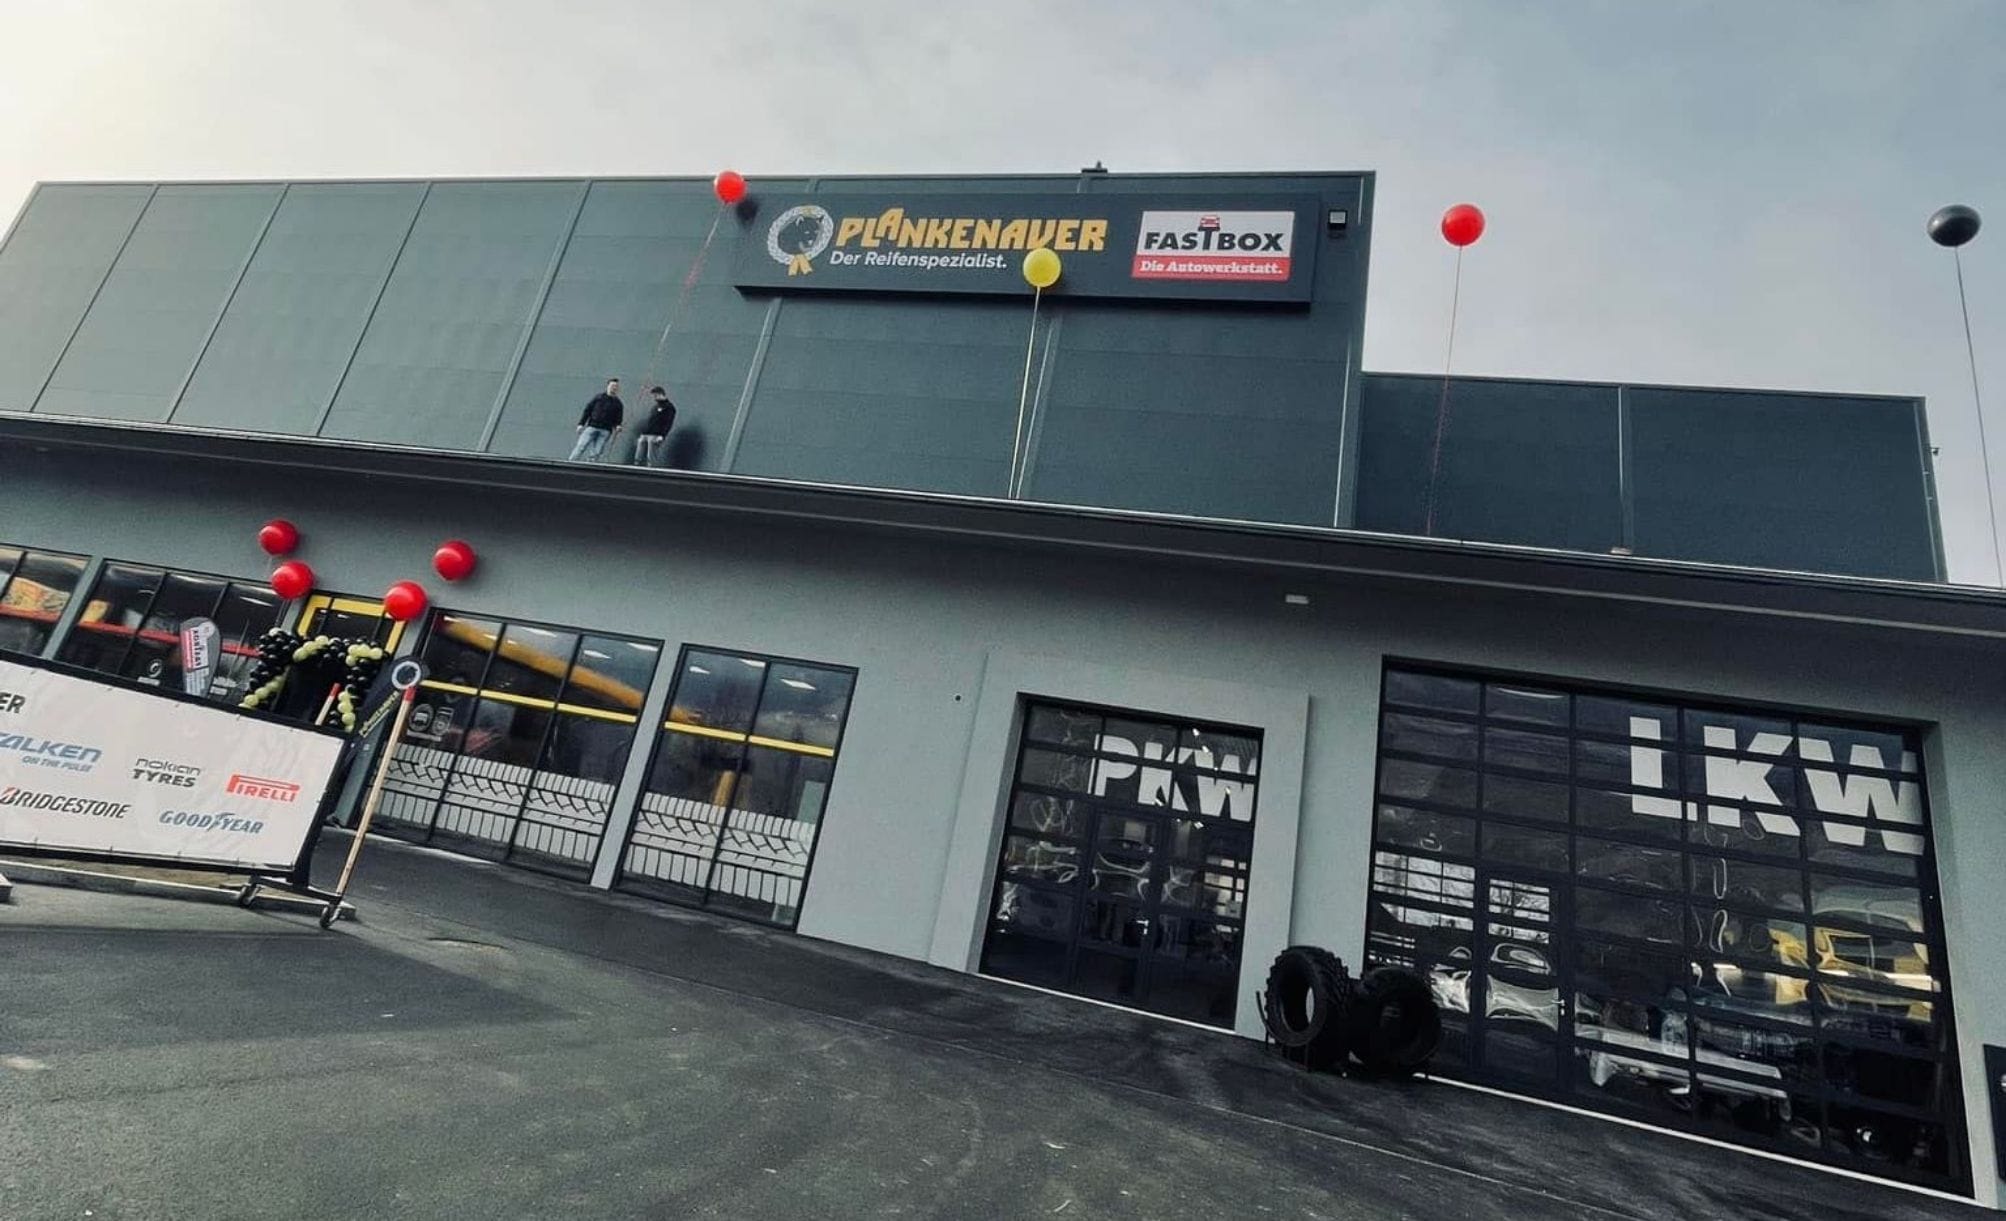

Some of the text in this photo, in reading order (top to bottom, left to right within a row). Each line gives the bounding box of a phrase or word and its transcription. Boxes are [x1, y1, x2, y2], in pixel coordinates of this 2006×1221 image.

[1144, 226, 1284, 251] FASTBOX
[830, 251, 1007, 270] Der Reifenspezialist.
[1140, 260, 1283, 274] Die Autowerkstatt.
[132, 769, 197, 788] TYRES
[226, 774, 300, 802] PIRELLI
[1088, 733, 1257, 822] PKW
[1630, 716, 1925, 856] LKW
[0, 786, 132, 819] BRIDGESTONE
[159, 810, 264, 834] GOODYEAR
